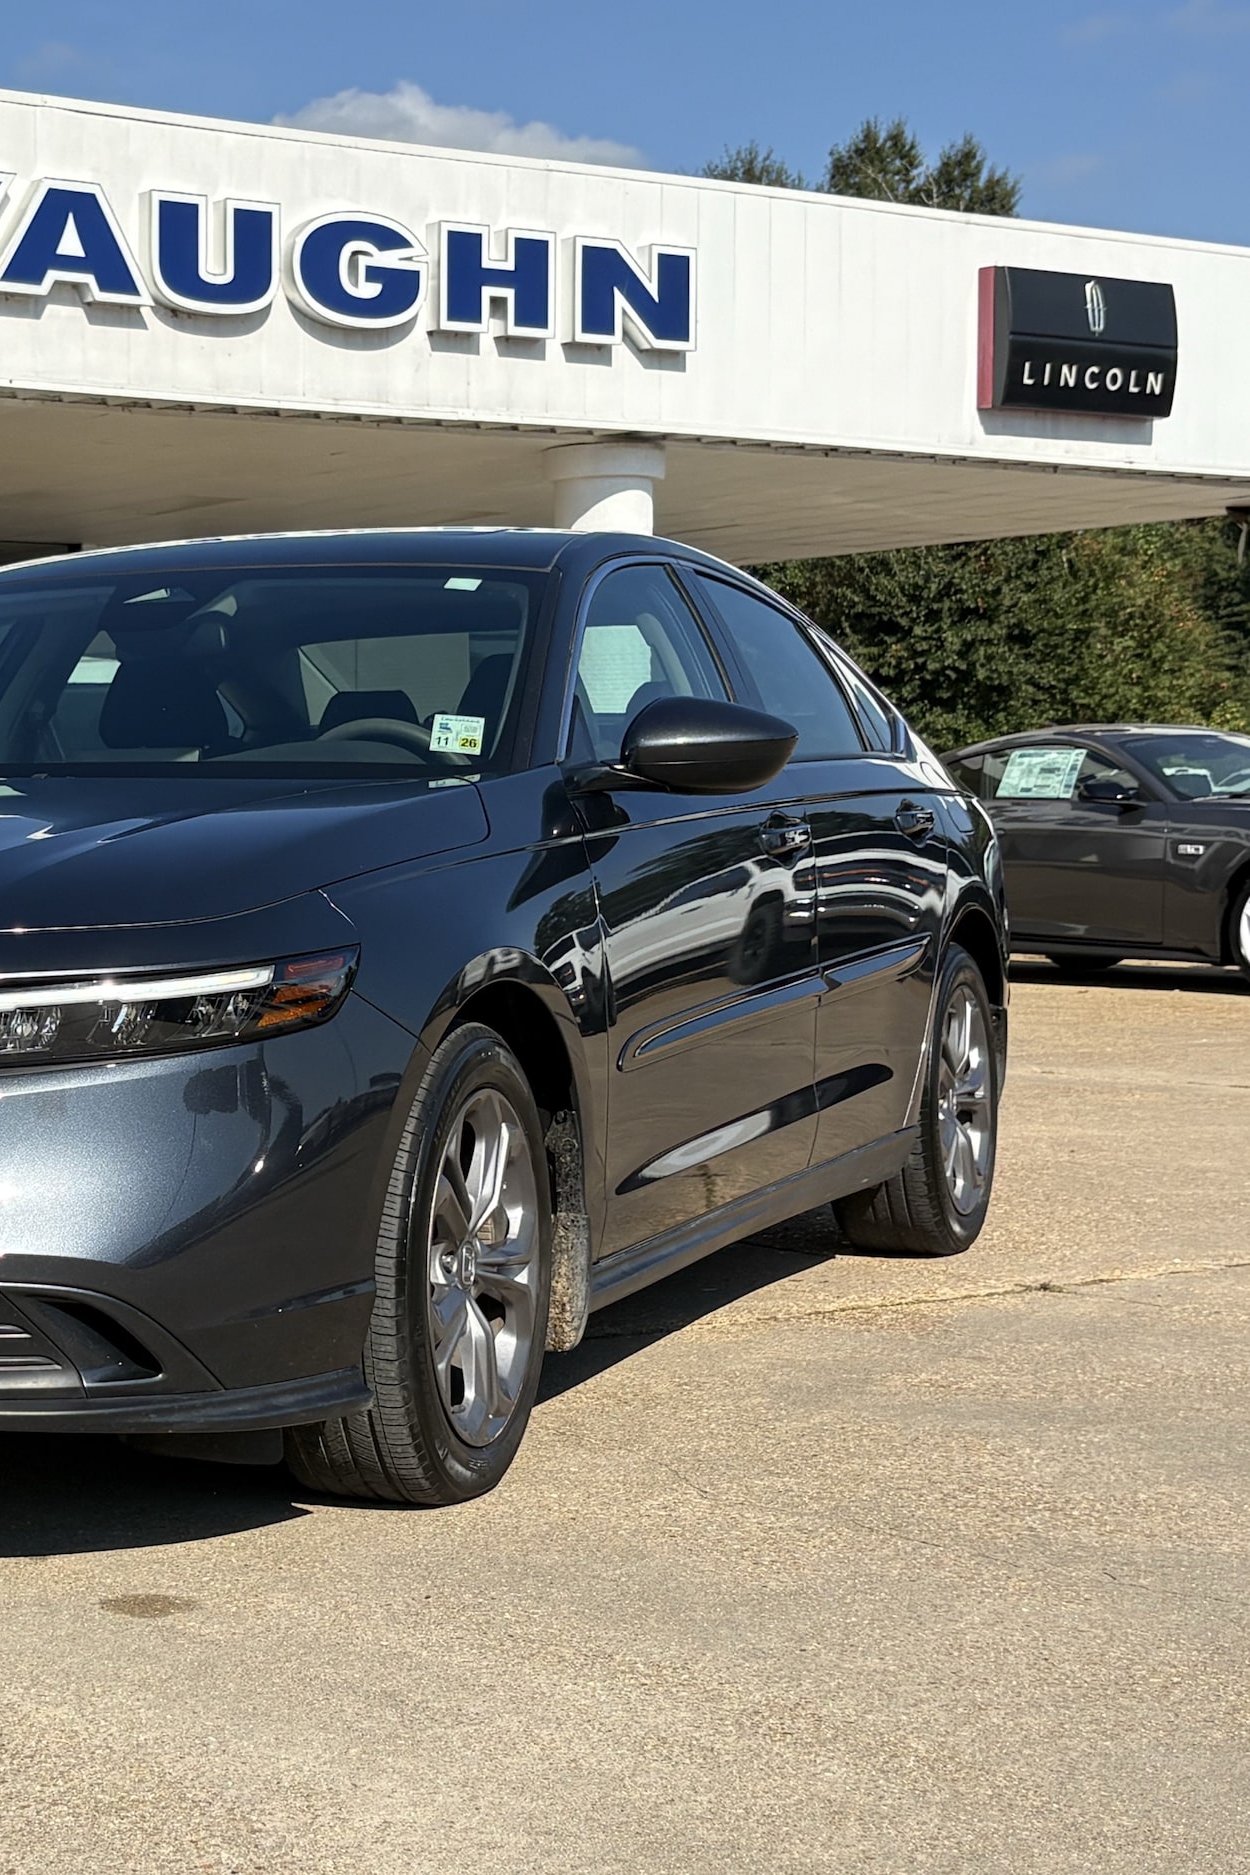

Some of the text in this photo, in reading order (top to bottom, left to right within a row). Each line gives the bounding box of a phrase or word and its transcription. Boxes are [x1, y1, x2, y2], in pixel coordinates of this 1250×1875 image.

[1021, 360, 1165, 396] LINCOLN
[435, 736, 478, 748] 11 26
